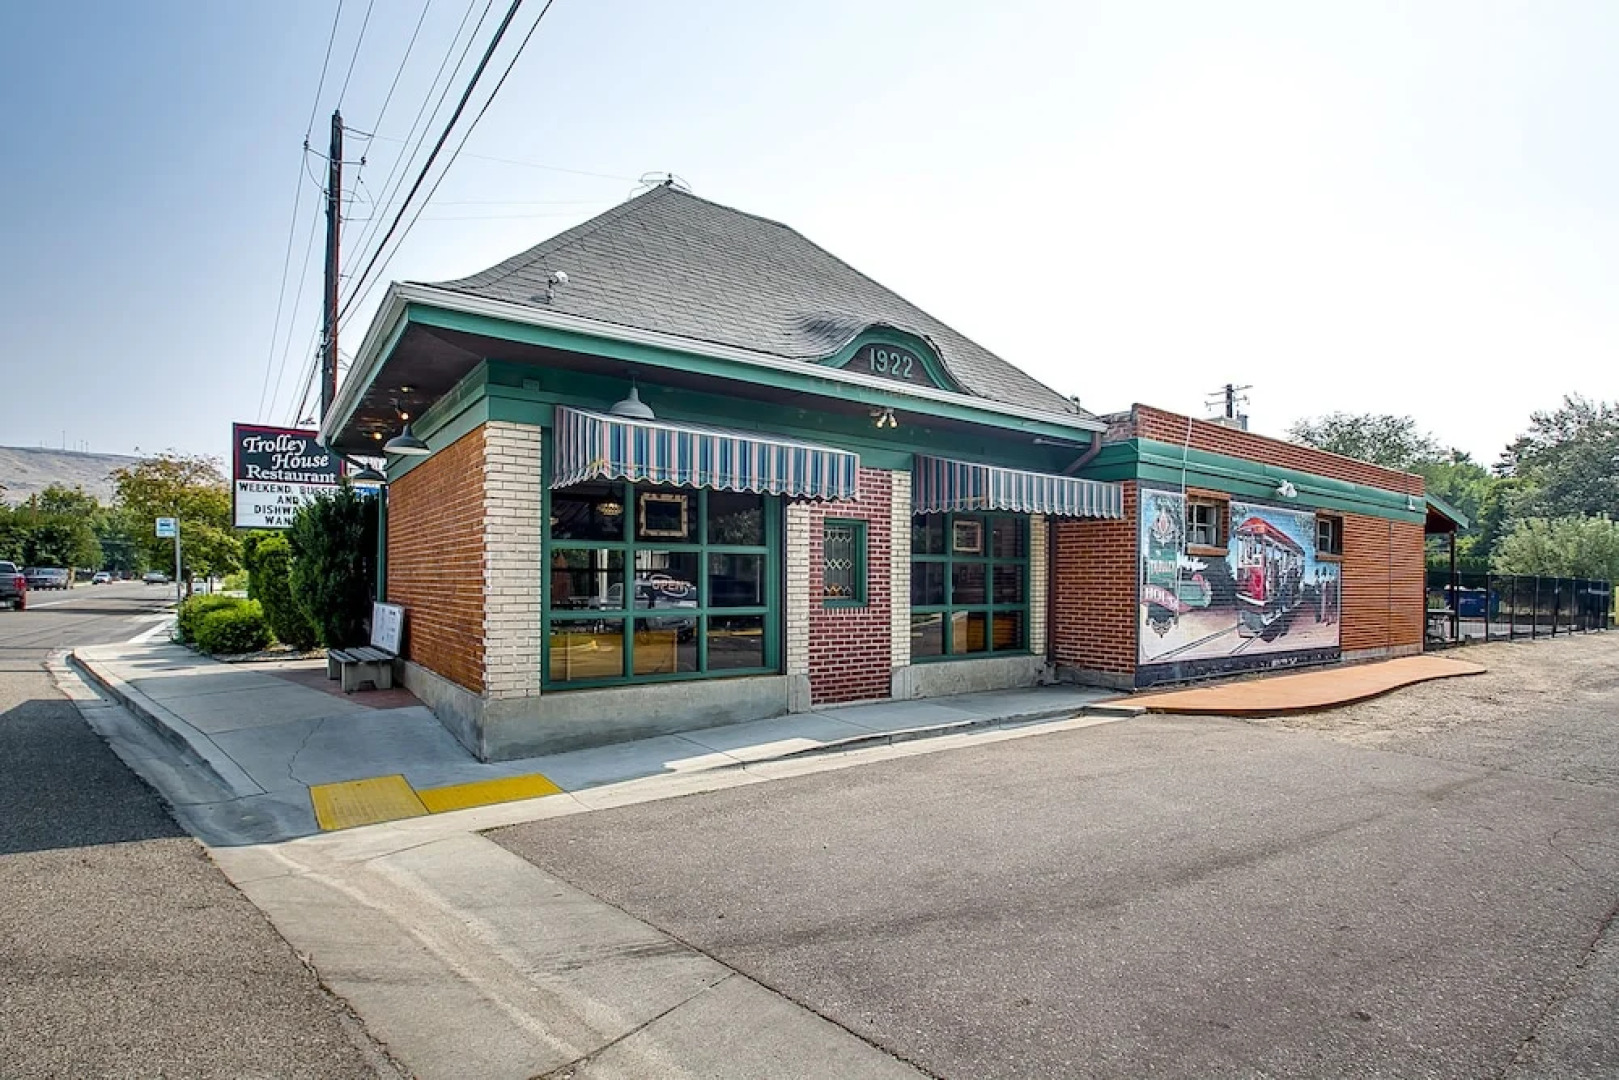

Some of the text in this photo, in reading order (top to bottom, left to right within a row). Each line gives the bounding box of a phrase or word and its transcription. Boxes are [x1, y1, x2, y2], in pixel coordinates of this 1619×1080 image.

[870, 347, 913, 378] 1922
[242, 434, 307, 456] Trolley
[271, 452, 330, 470] House
[245, 464, 336, 484] Restaurant
[239, 482, 292, 493] WEEKEND
[277, 495, 299, 504] AND
[652, 579, 684, 592] OPEN
